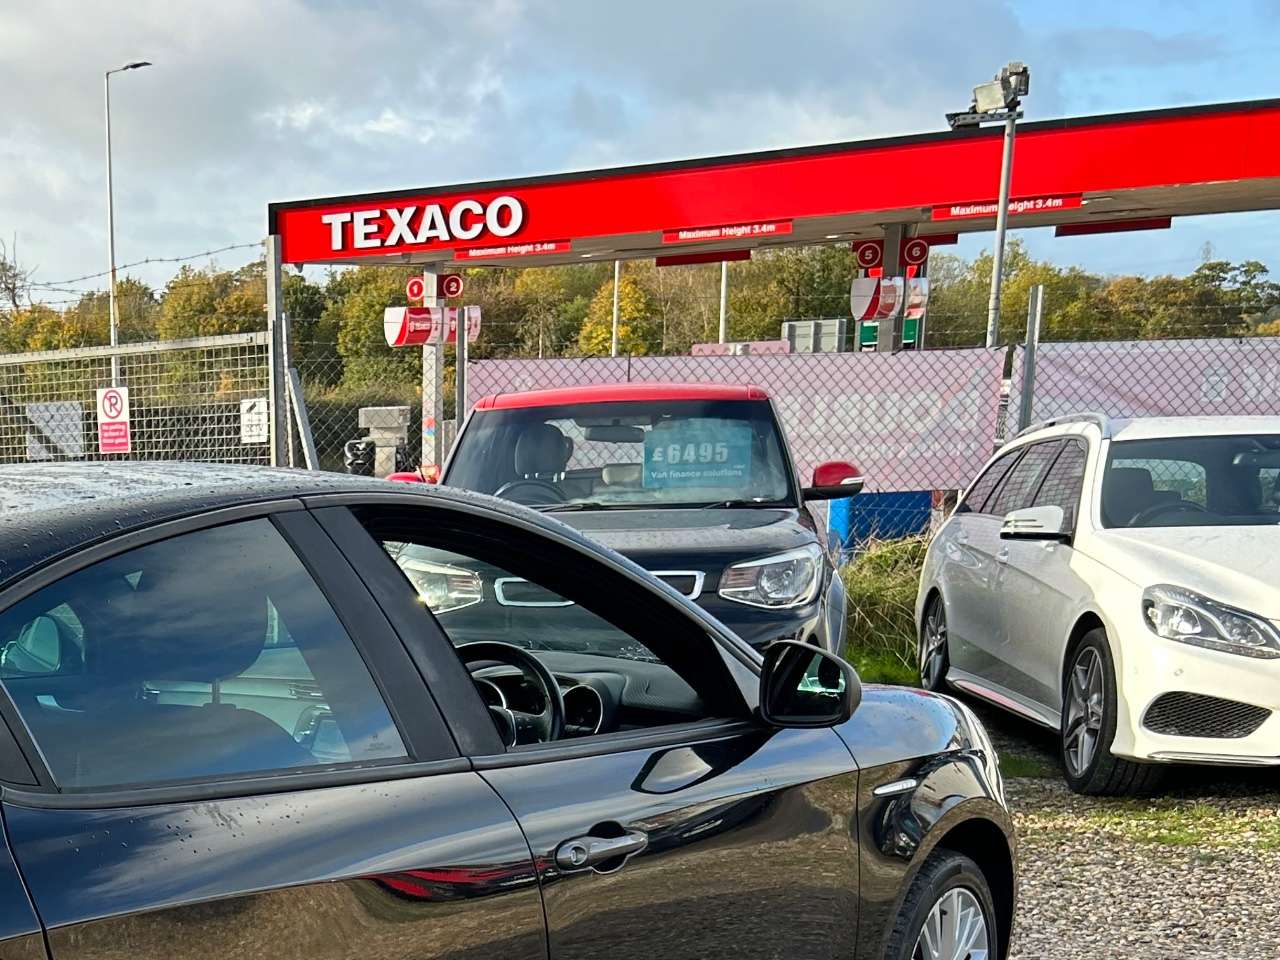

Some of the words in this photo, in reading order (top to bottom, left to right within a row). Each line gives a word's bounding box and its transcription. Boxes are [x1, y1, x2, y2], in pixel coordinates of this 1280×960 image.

[950, 204, 998, 216] Maximum
[1008, 201, 1035, 212] eight
[1036, 198, 1063, 208] 3.4m
[321, 195, 523, 250] TEXACO
[678, 229, 720, 239] Maximum
[721, 226, 751, 236] Height
[753, 224, 776, 233] 3.4m
[864, 250, 873, 260] 5
[912, 247, 921, 257] 6
[412, 284, 419, 294] 1
[449, 282, 457, 291] 2
